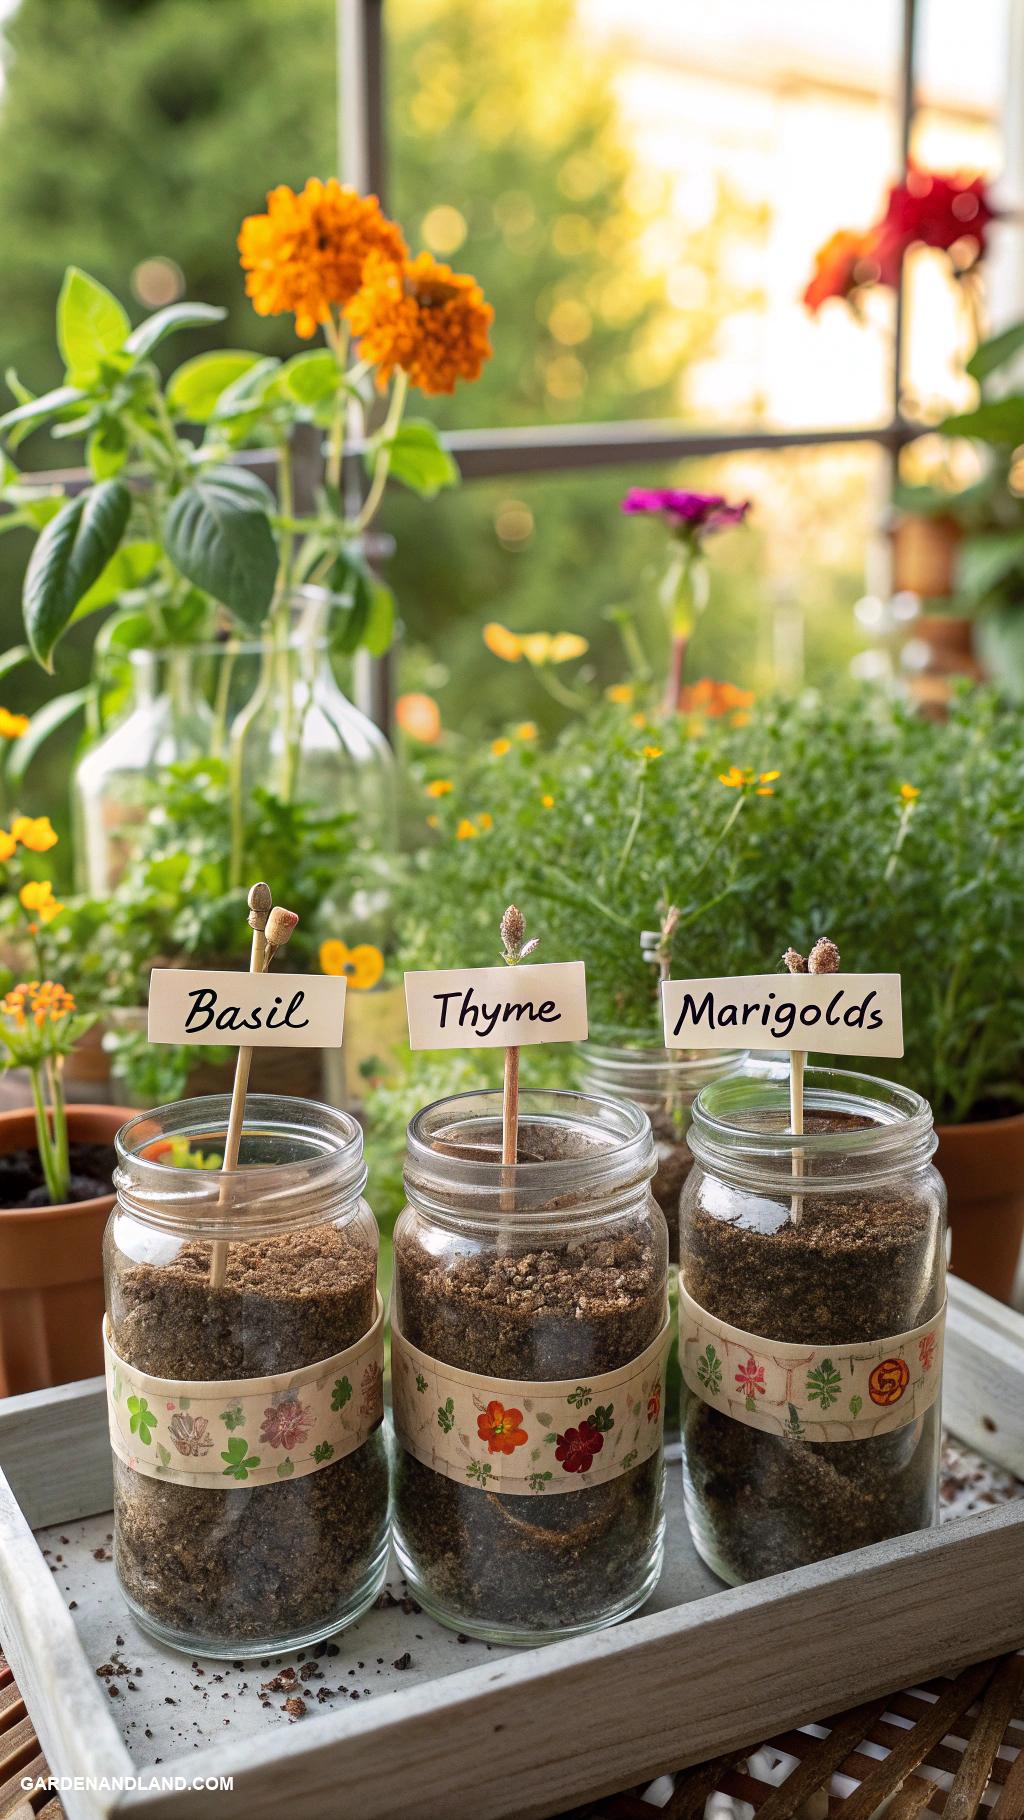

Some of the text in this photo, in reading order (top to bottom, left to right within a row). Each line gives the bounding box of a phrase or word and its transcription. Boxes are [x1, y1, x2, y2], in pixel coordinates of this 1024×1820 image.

[185, 988, 310, 1034] Basil
[432, 987, 562, 1037] Thyme
[672, 990, 884, 1039] Marigolds
